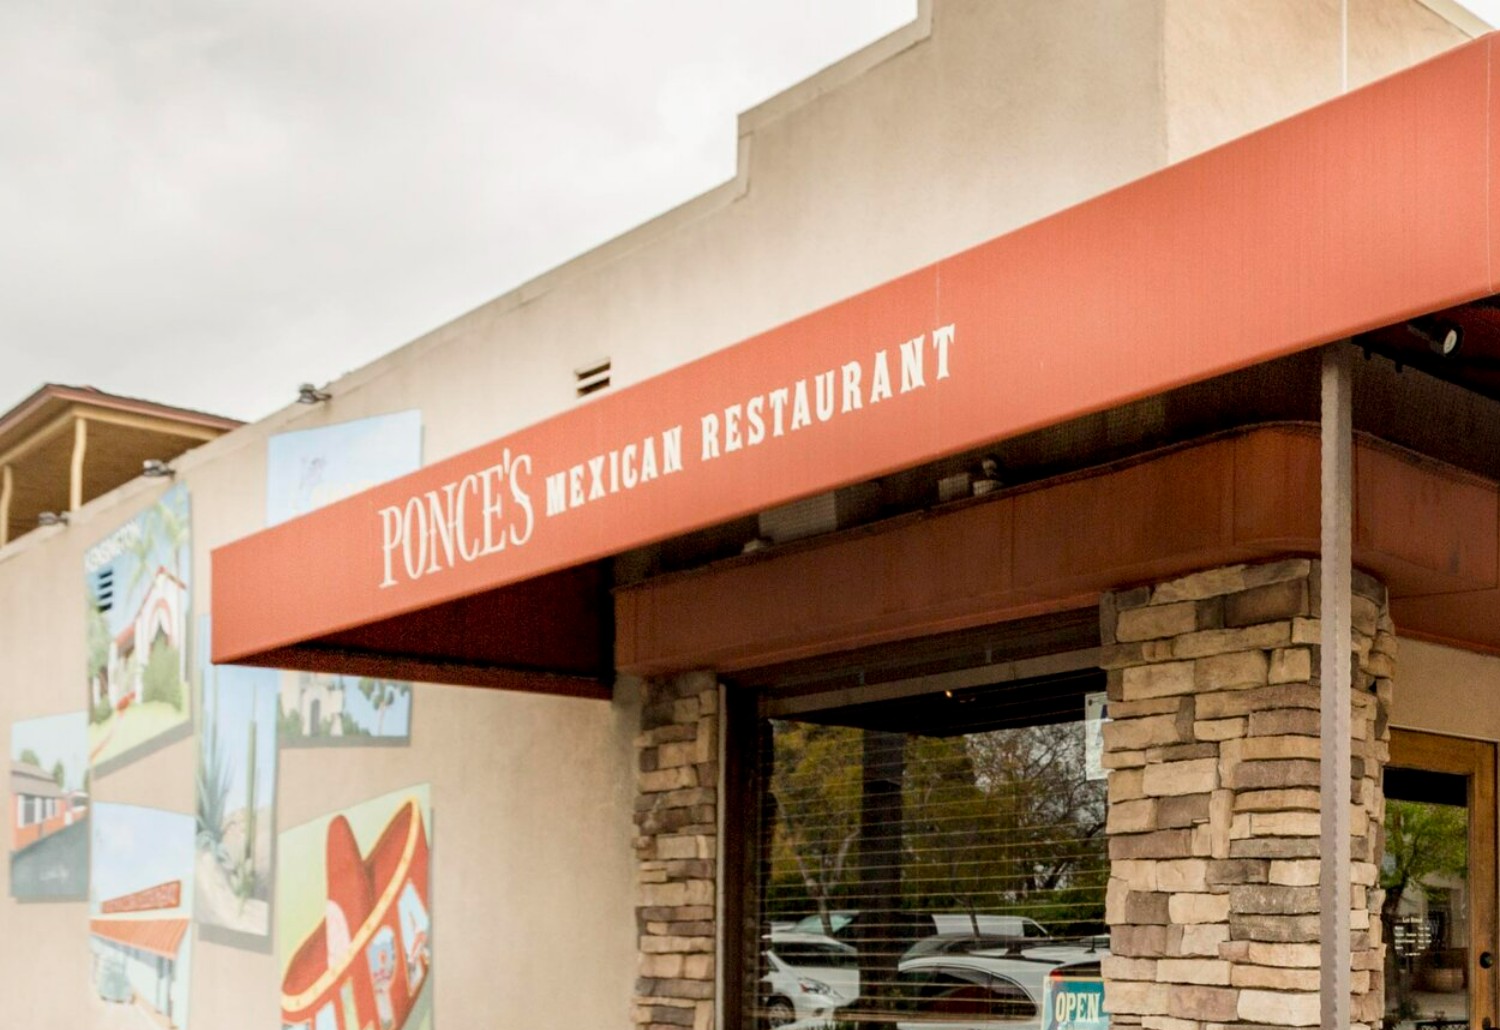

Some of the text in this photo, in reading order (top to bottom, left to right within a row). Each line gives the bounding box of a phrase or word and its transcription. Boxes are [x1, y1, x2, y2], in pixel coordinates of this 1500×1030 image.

[377, 323, 956, 589] PONCE'S MEXICAN RESTAURANT
[1055, 991, 1101, 1023] OPEN
